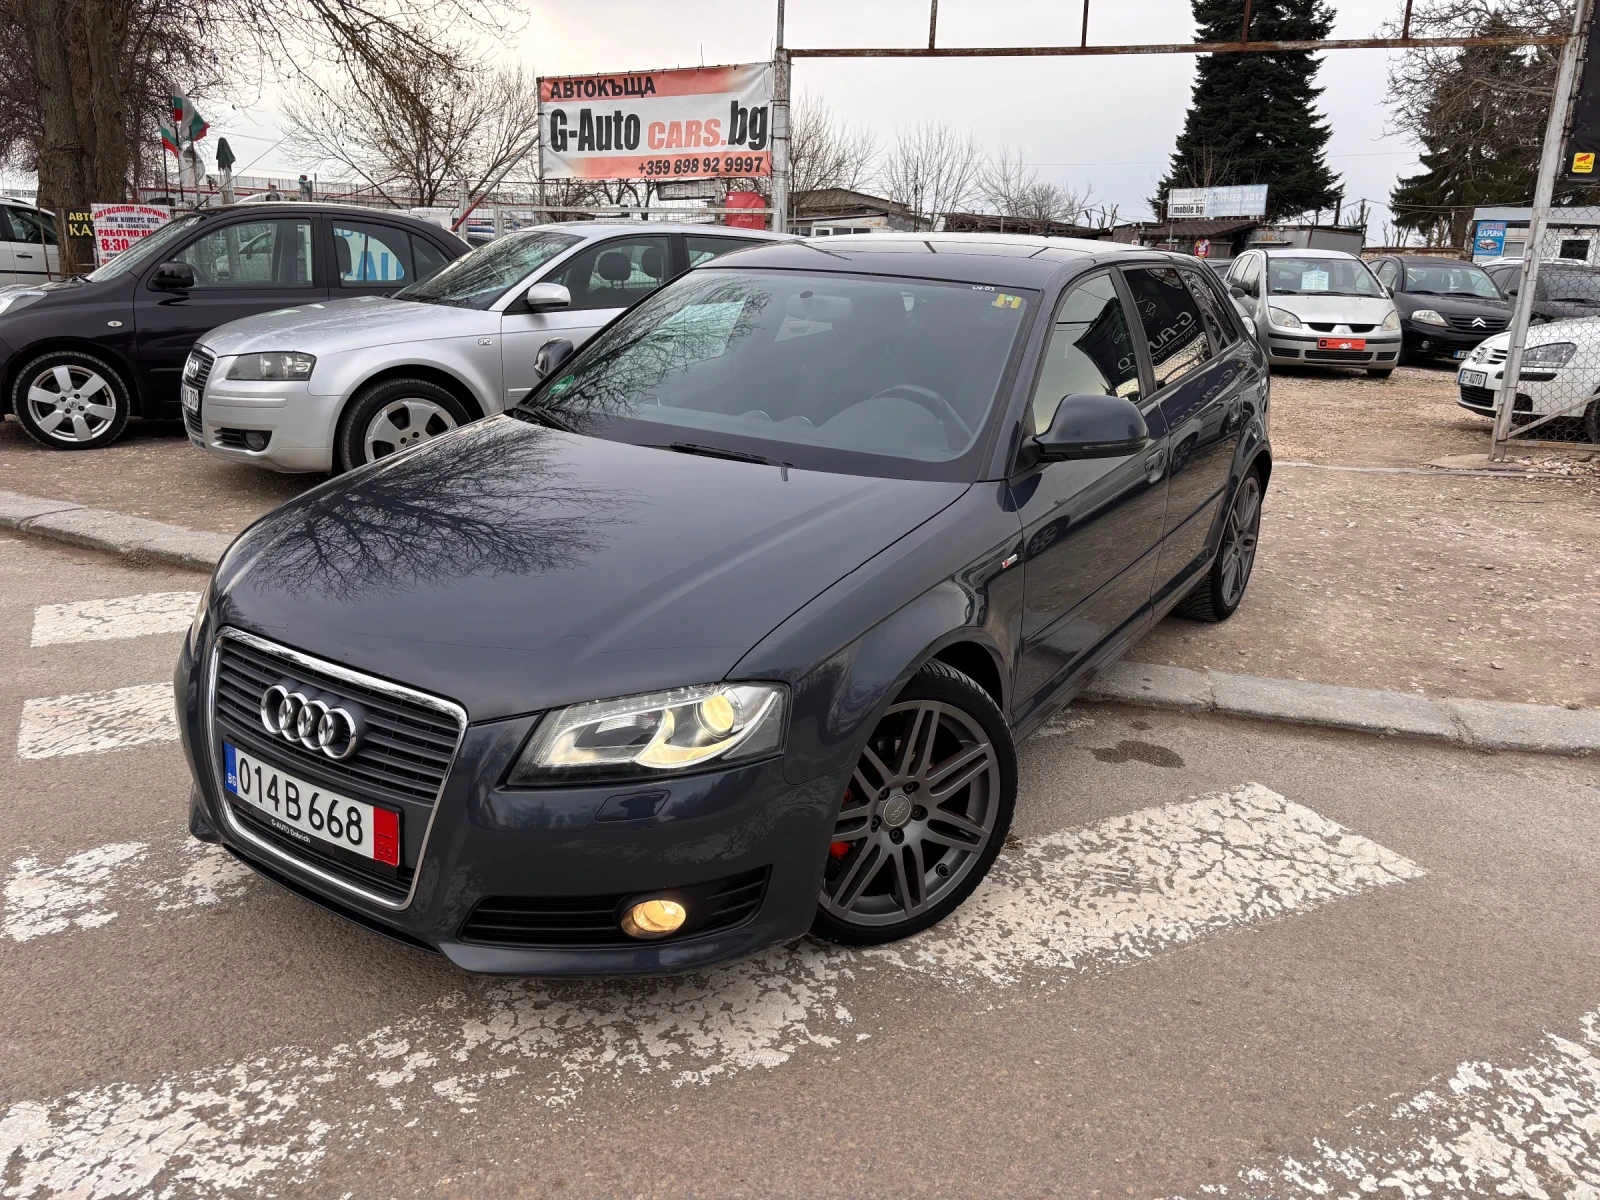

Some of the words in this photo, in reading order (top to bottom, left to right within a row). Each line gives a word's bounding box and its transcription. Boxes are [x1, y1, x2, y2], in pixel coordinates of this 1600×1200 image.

[550, 76, 656, 98] АВТОКЪЩА
[550, 108, 641, 152] G-Auto
[638, 158, 671, 176] +359
[673, 156, 699, 174] 898
[702, 156, 720, 173] 92
[724, 156, 764, 173] 9997
[1243, 192, 1265, 201] 2012
[94, 205, 135, 219] АВТОСАЛОН
[68, 223, 94, 237] КА
[101, 238, 129, 251] 8:30
[227, 772, 237, 787] BG
